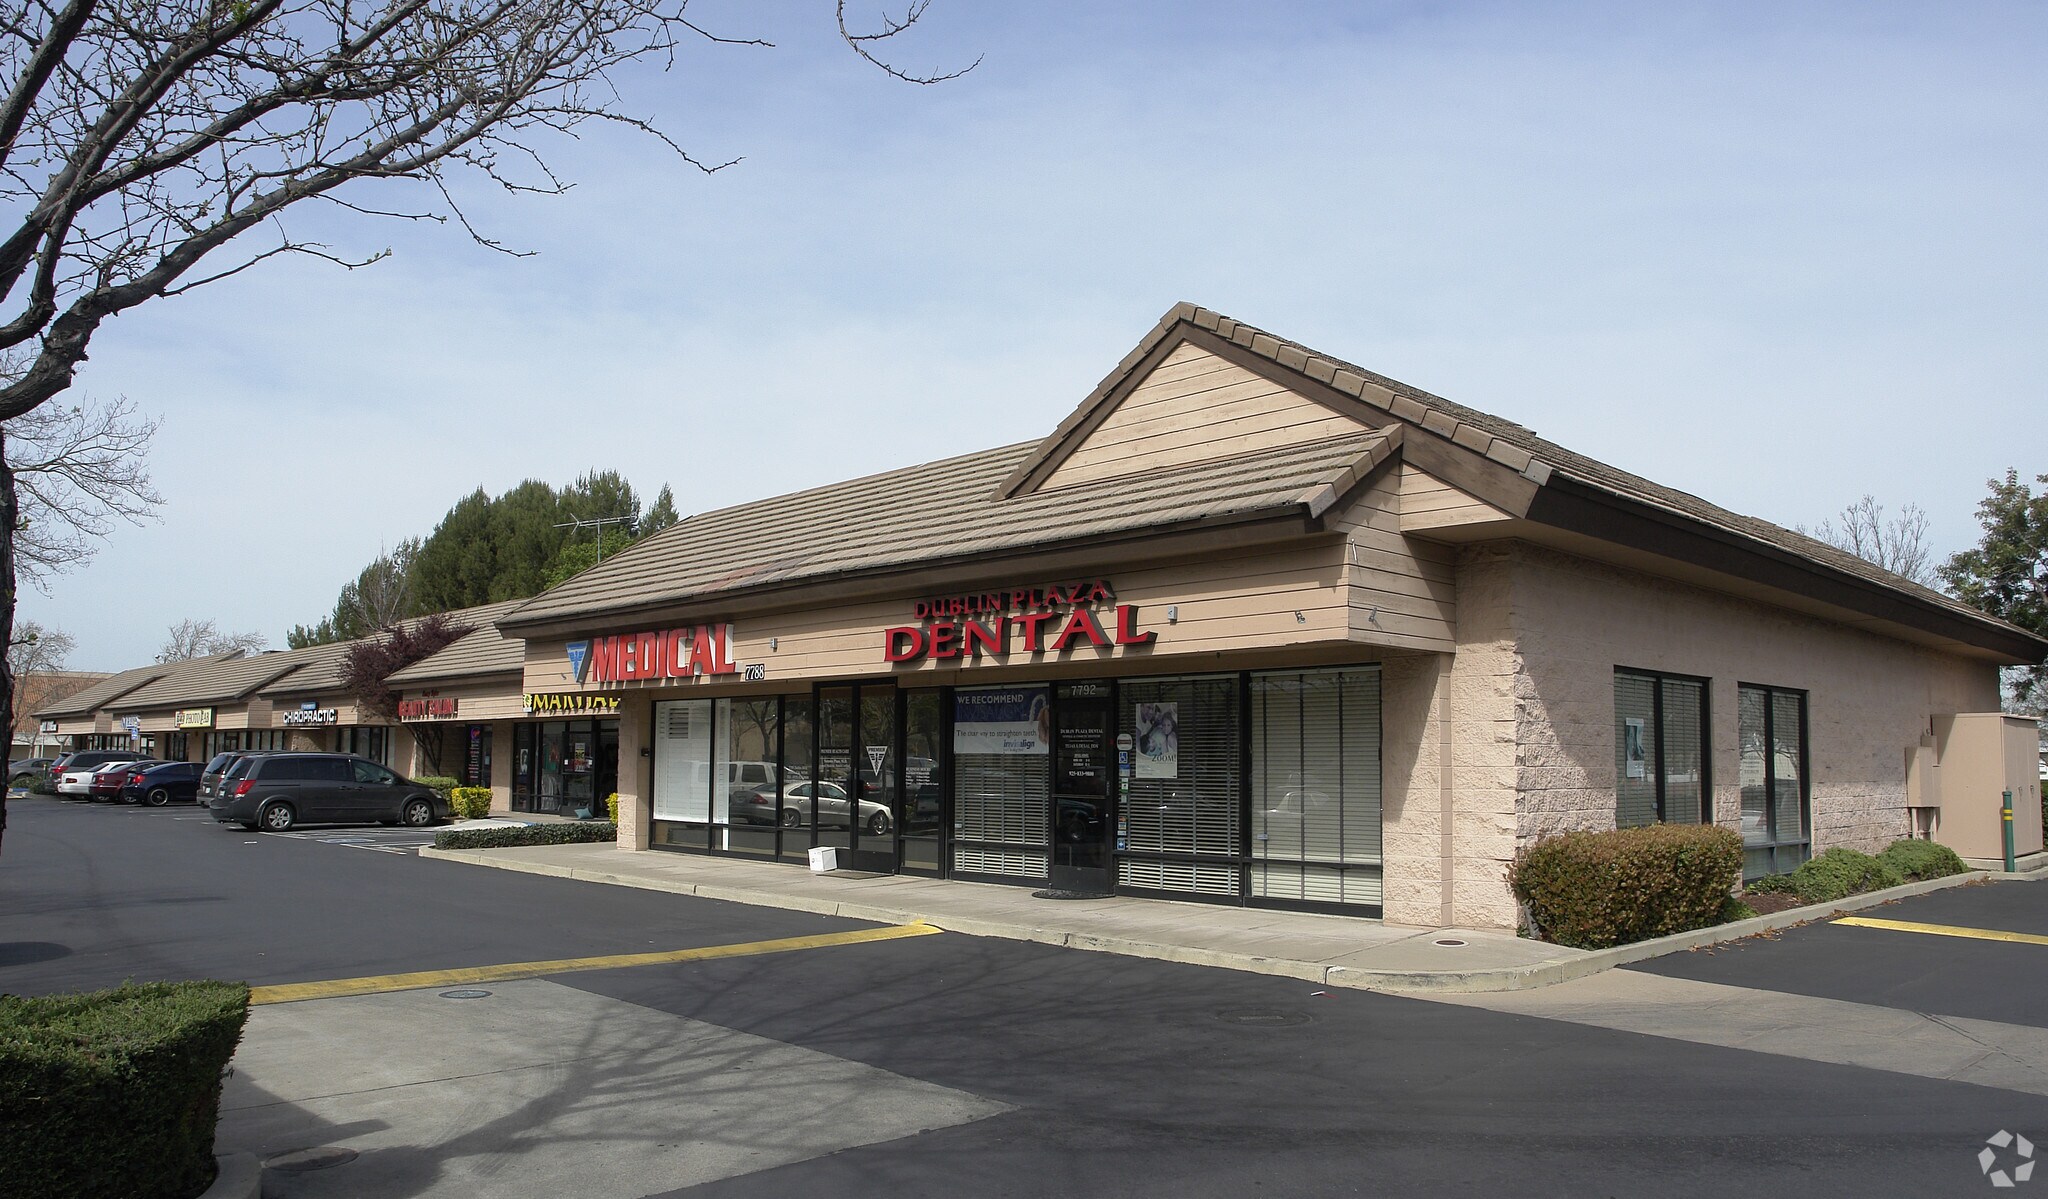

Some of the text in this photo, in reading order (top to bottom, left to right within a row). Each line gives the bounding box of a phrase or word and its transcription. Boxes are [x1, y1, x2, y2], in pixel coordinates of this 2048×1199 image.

[914, 579, 1110, 619] DUBLIN PLAZA
[884, 604, 1152, 662] DENTAL
[592, 623, 737, 682] MEDICAL
[745, 664, 765, 680] 7788
[957, 694, 1024, 704] WE RECOMMEND
[1071, 684, 1096, 696] 7792
